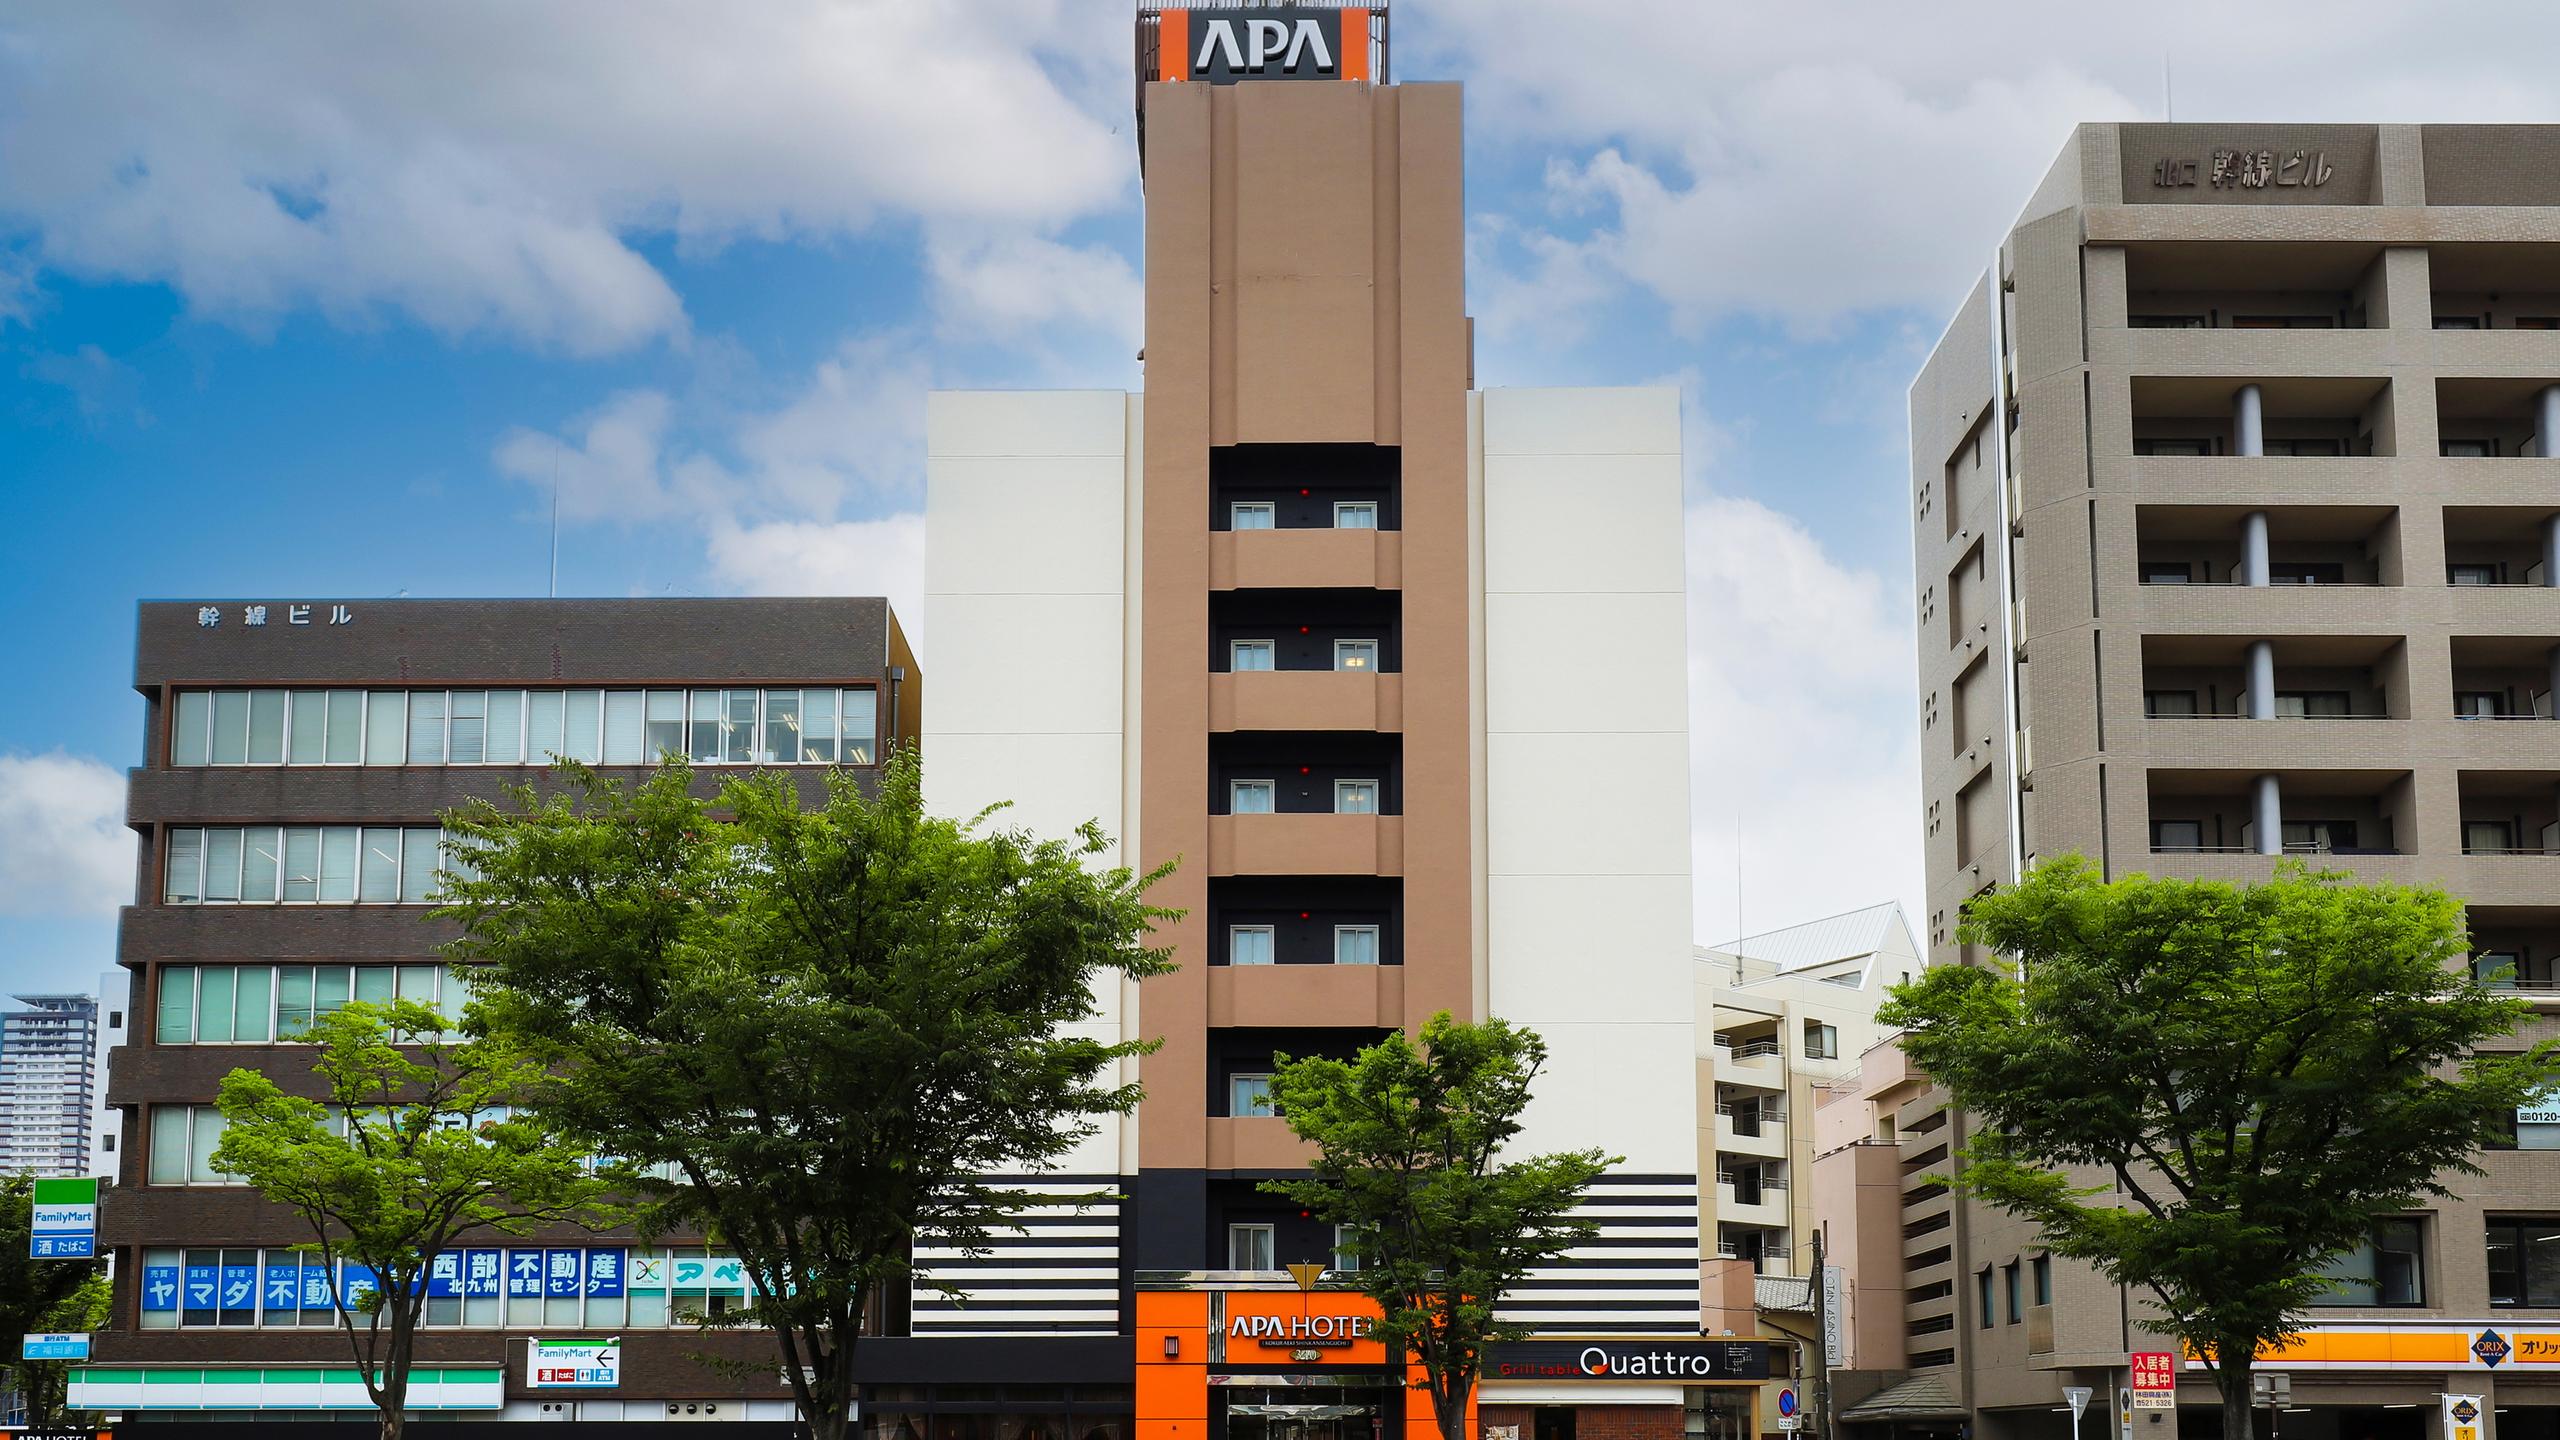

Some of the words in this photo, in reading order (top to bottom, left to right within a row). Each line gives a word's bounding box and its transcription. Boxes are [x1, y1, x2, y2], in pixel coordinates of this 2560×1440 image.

[1195, 19, 1335, 74] APA
[2212, 150, 2333, 188] 幹線ビル
[198, 604, 352, 627] 幹線ビル
[35, 1211, 92, 1224] FamilyMart
[38, 1240, 53, 1255] 酒
[58, 1240, 88, 1253] たばこ
[433, 1253, 616, 1279] 西部不動産
[448, 1278, 618, 1294] 北九州管理センター
[1231, 1315, 1285, 1337] APA
[1825, 1308, 1838, 1344] ASANO
[538, 1348, 592, 1360] FamilyMart
[2476, 1341, 2505, 1352] ORIX
[1500, 1362, 1535, 1376] Grill
[1539, 1362, 1581, 1376] table
[1580, 1346, 1710, 1375] Quattro
[2135, 1356, 2169, 1370] 入居者
[2135, 1373, 2170, 1386] 募集中
